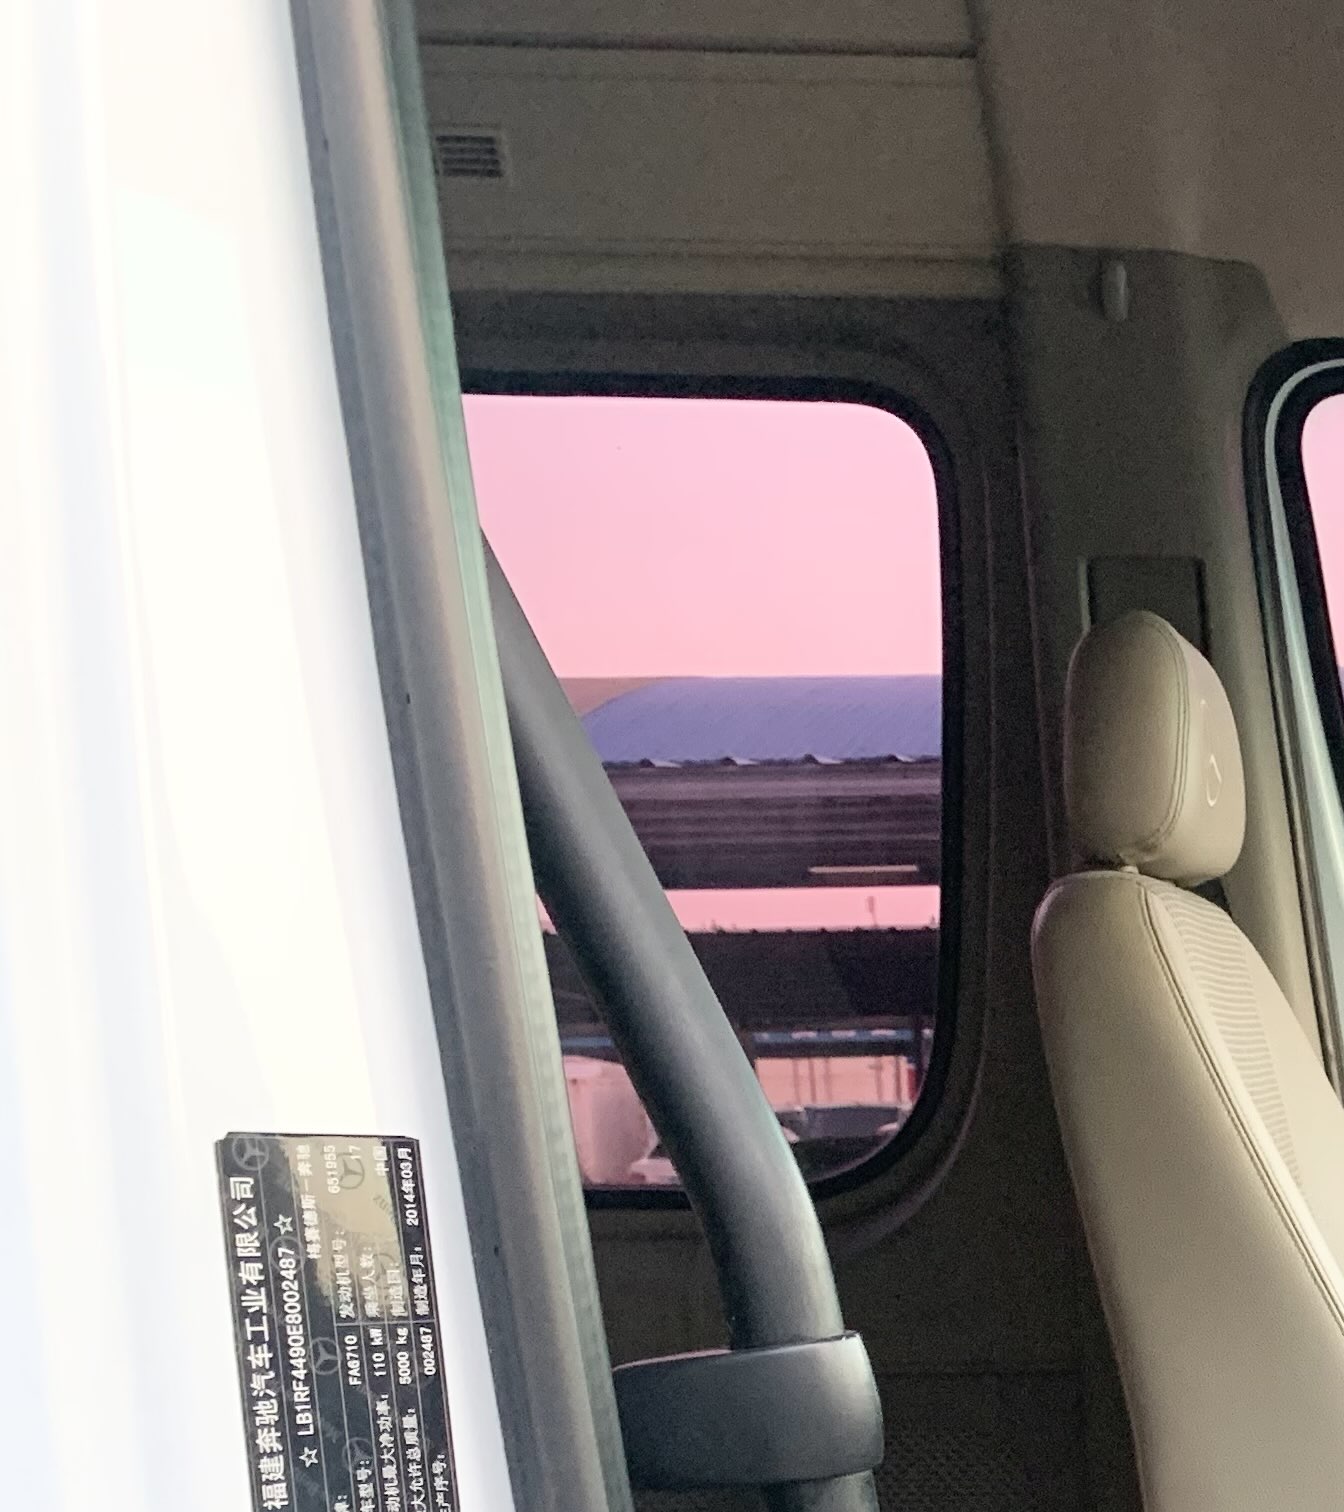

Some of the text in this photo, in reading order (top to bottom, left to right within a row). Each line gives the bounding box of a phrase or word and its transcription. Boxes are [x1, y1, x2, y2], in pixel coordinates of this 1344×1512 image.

[323, 1144, 340, 1193] 651955
[349, 1145, 361, 1159] 17
[372, 1145, 390, 1176] 中国
[397, 1147, 419, 1226] 2014年03月
[229, 1175, 289, 1510] 福建奔驰汽车工业有限公司
[278, 1246, 314, 1436] LB1RF4490E8002487
[344, 1334, 361, 1385] FA6710
[393, 1327, 409, 1344] kg
[419, 1325, 436, 1375] 002487
[371, 1351, 386, 1377] 110
[396, 1351, 412, 1384] 5000
